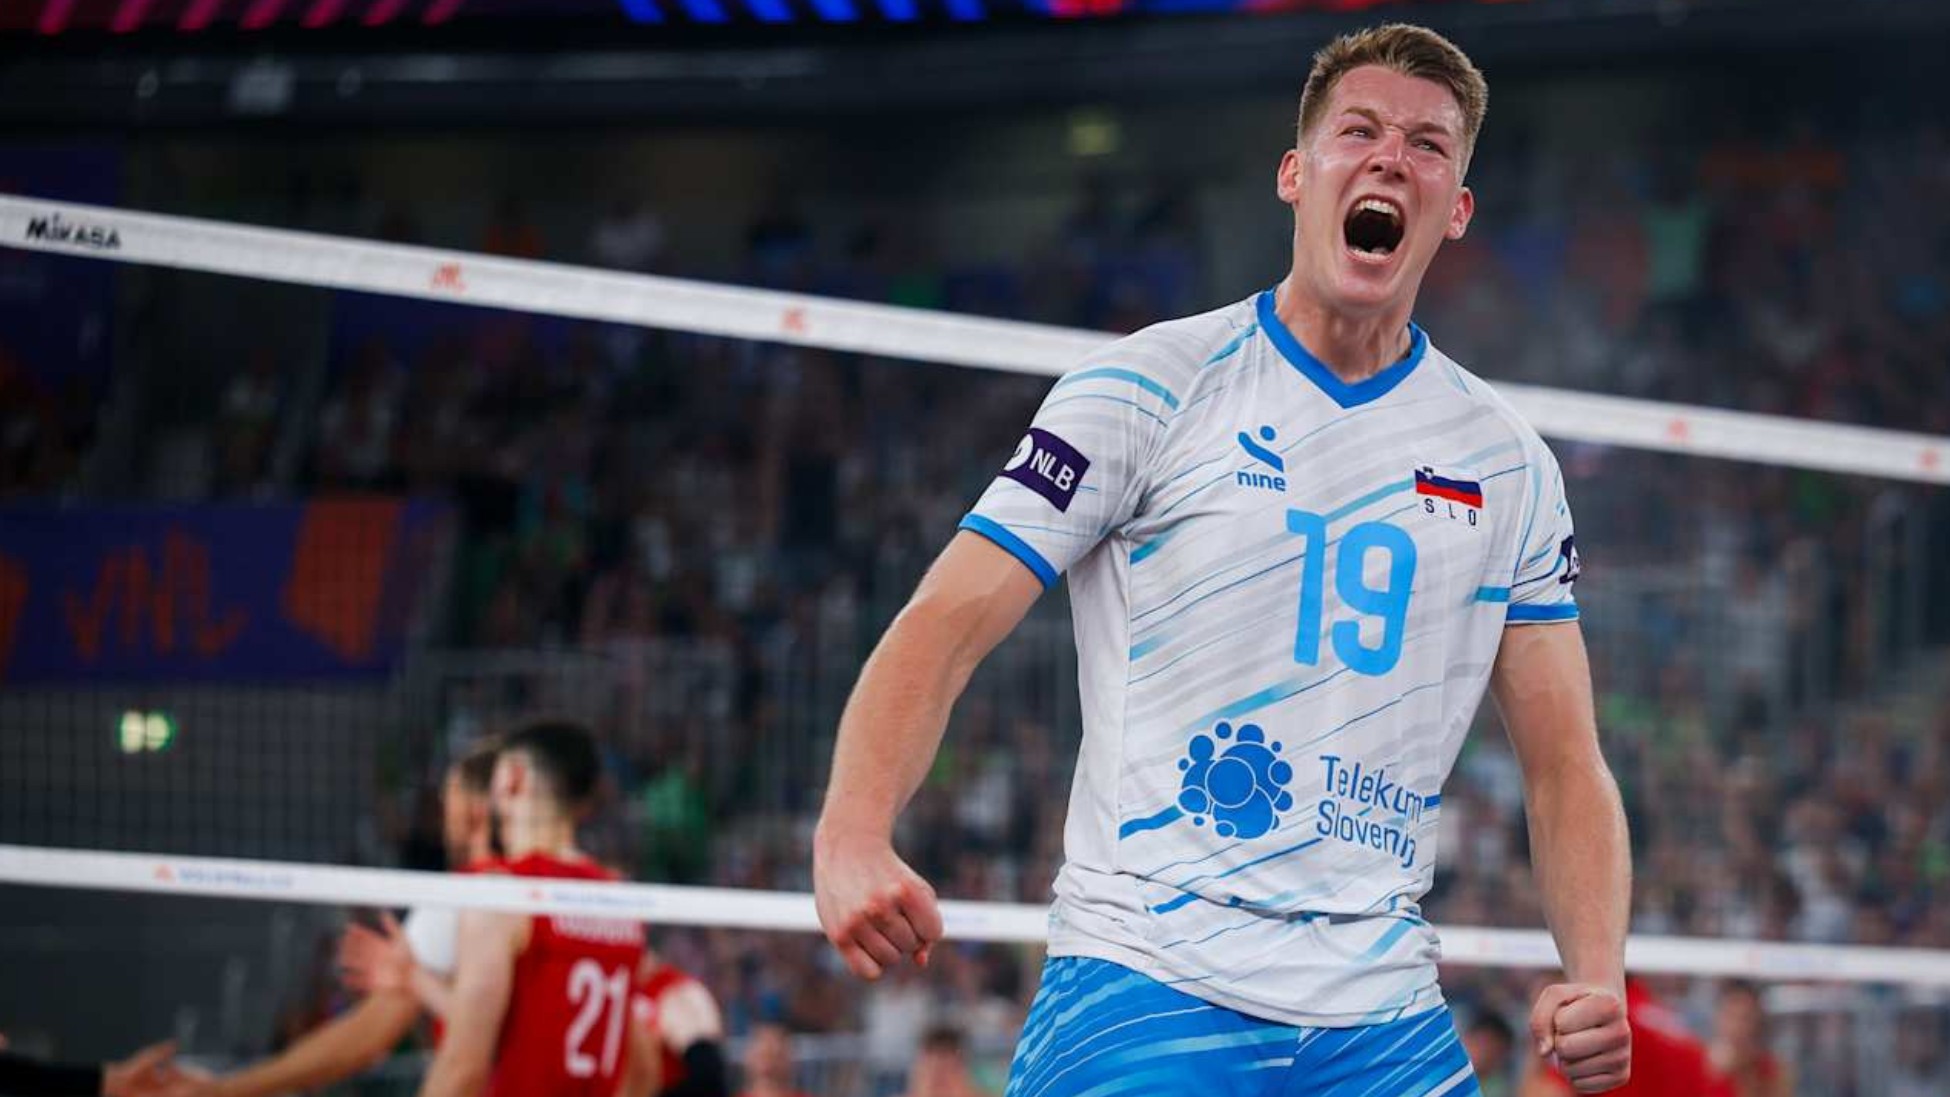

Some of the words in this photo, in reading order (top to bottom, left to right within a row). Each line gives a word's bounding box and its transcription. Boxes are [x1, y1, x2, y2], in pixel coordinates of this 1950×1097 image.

[1029, 448, 1075, 491] NLB
[1237, 471, 1286, 492] nine
[1286, 508, 1417, 677] 19
[565, 957, 630, 1077] 21
